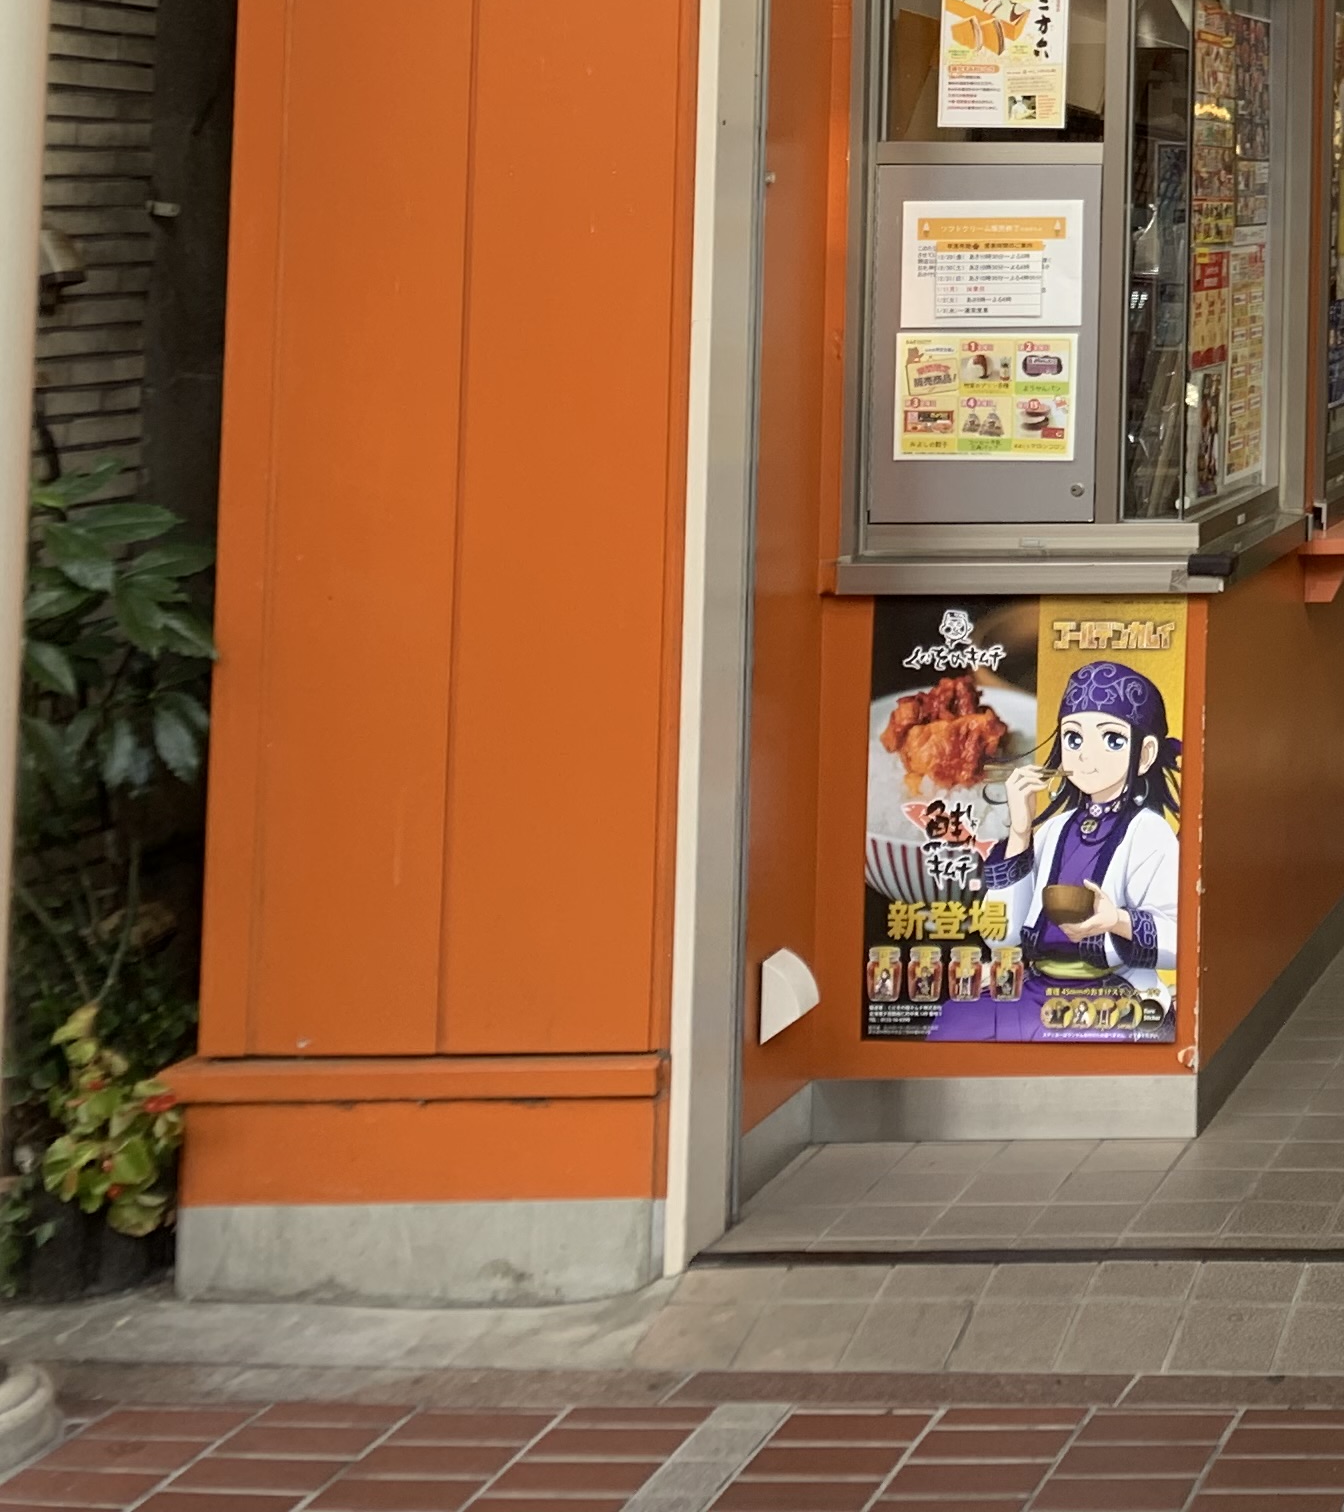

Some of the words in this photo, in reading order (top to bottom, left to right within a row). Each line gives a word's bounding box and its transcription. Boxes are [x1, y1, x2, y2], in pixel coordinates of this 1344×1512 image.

[1053, 620, 1176, 651] ゴールデンカムイ
[886, 901, 1009, 941] 新登場
